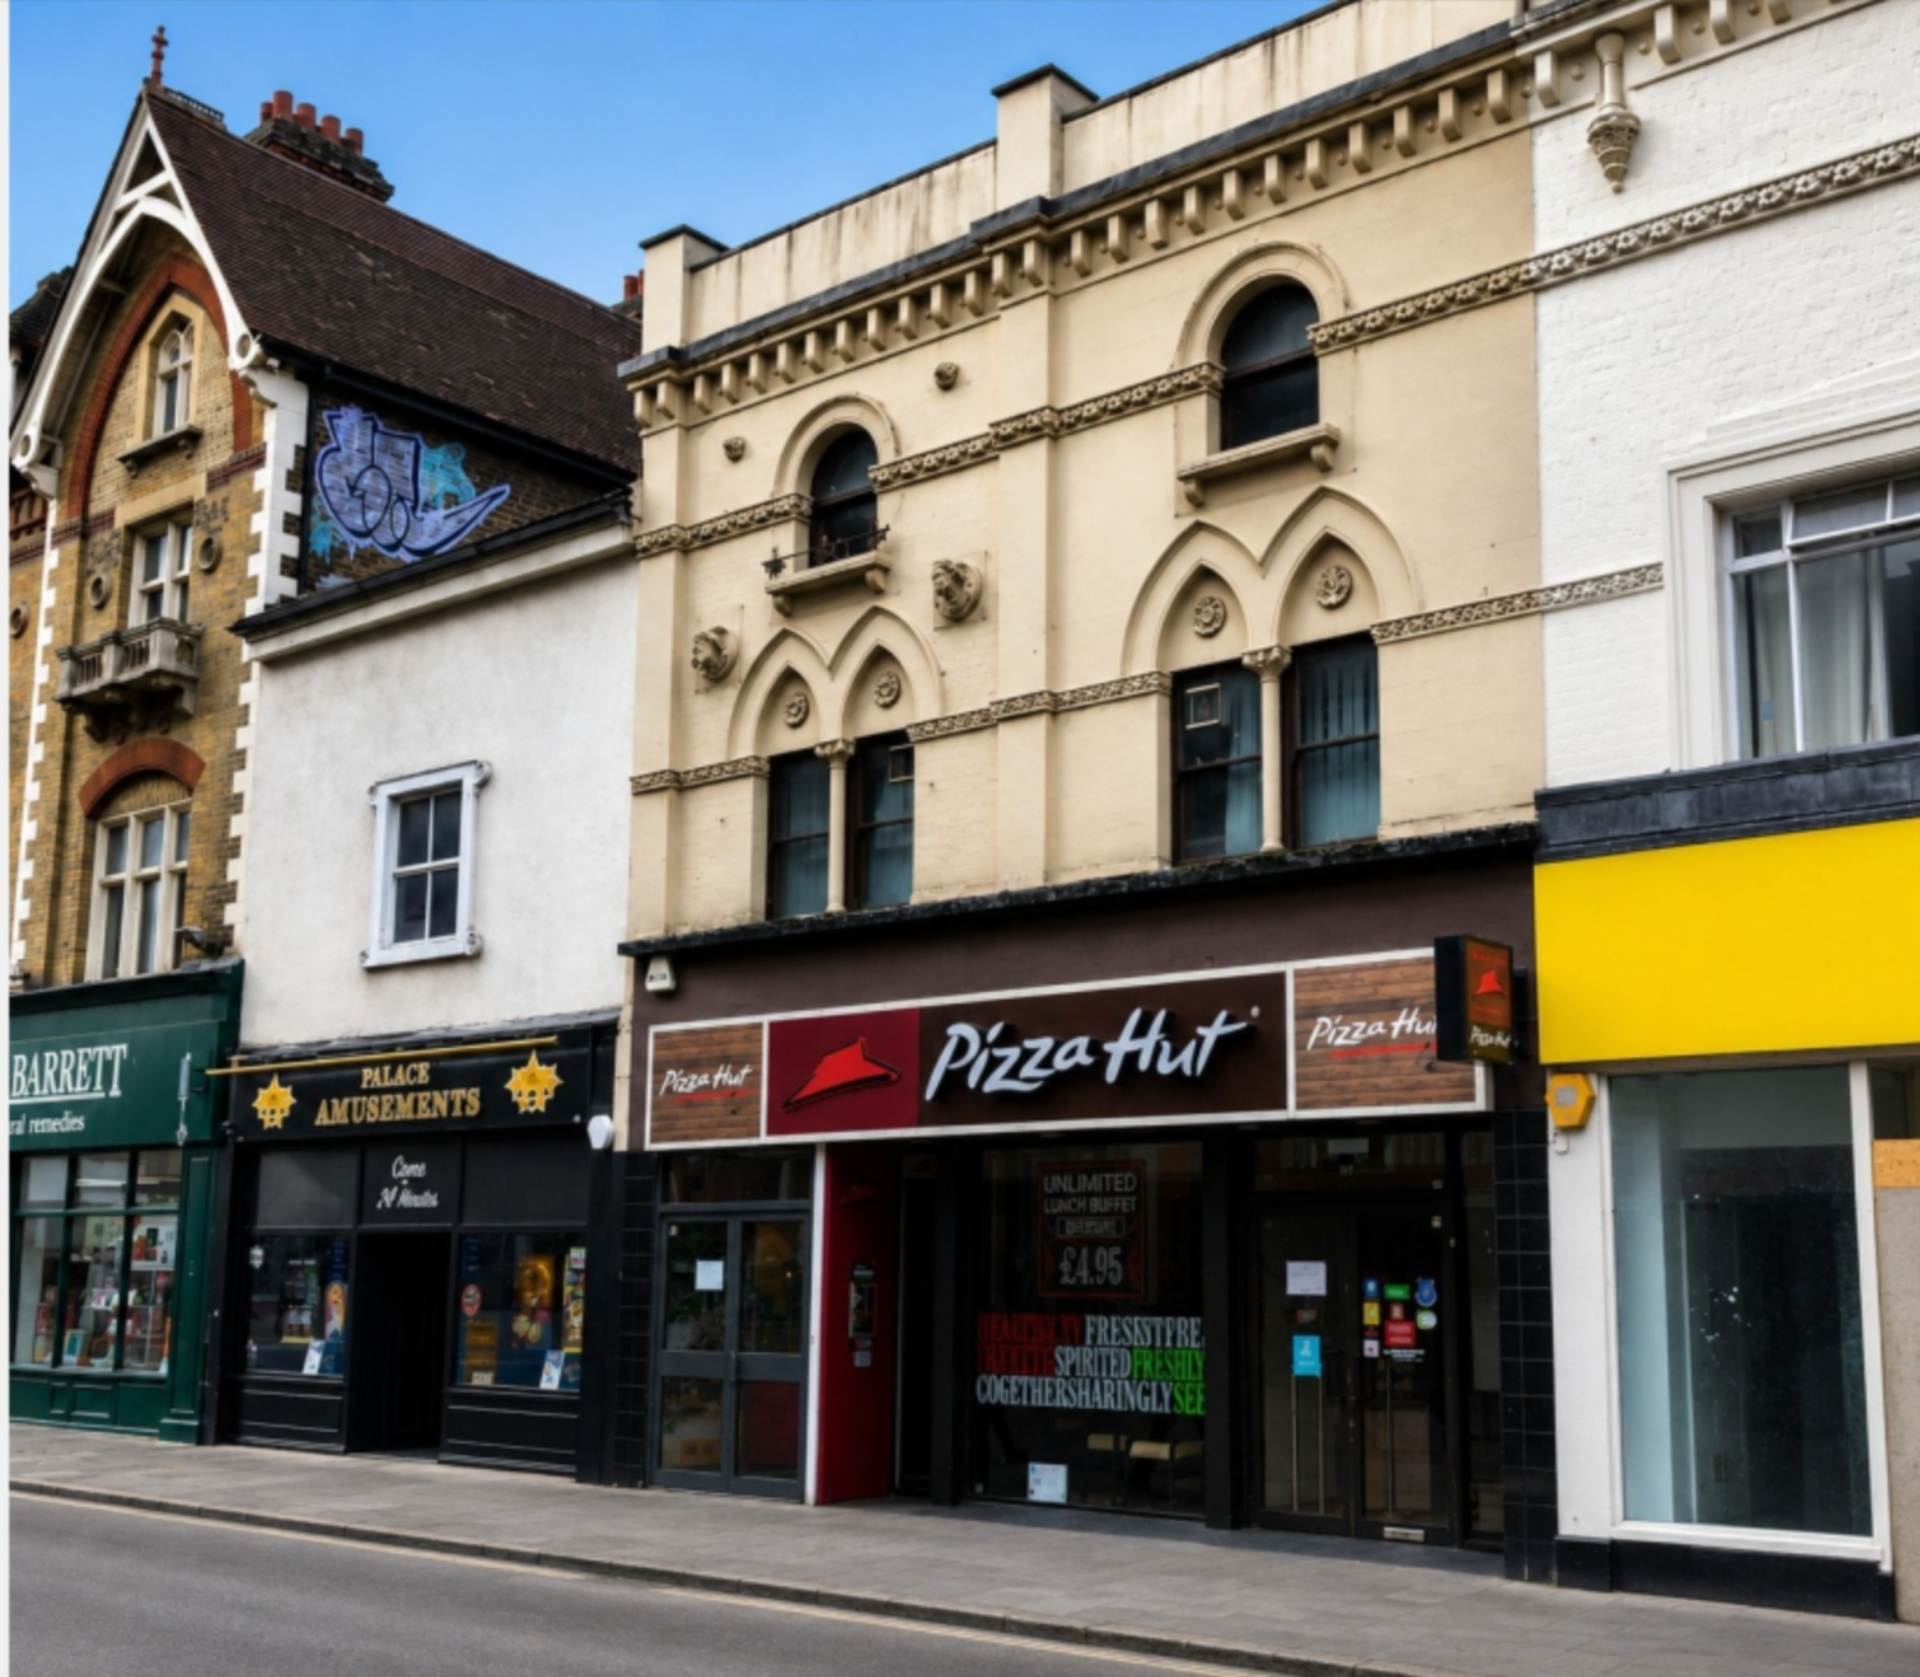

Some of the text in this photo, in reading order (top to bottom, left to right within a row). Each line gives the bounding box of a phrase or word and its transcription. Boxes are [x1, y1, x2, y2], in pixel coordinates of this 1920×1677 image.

[1307, 1014, 1388, 1051] Pizza
[11, 1043, 128, 1098] BARRETT
[925, 1007, 1248, 1101] Pizza Hut
[360, 1062, 431, 1089] PALACE
[659, 1064, 753, 1097] Pizza Hut
[29, 1110, 86, 1135] remedies
[314, 1087, 482, 1126] AMUSEMENTS
[1043, 1172, 1138, 1194] UNLIMITED
[1089, 1195, 1138, 1213] BUFFET
[1058, 1245, 1124, 1286] £4.95
[1054, 1345, 1132, 1379] SPIRITED
